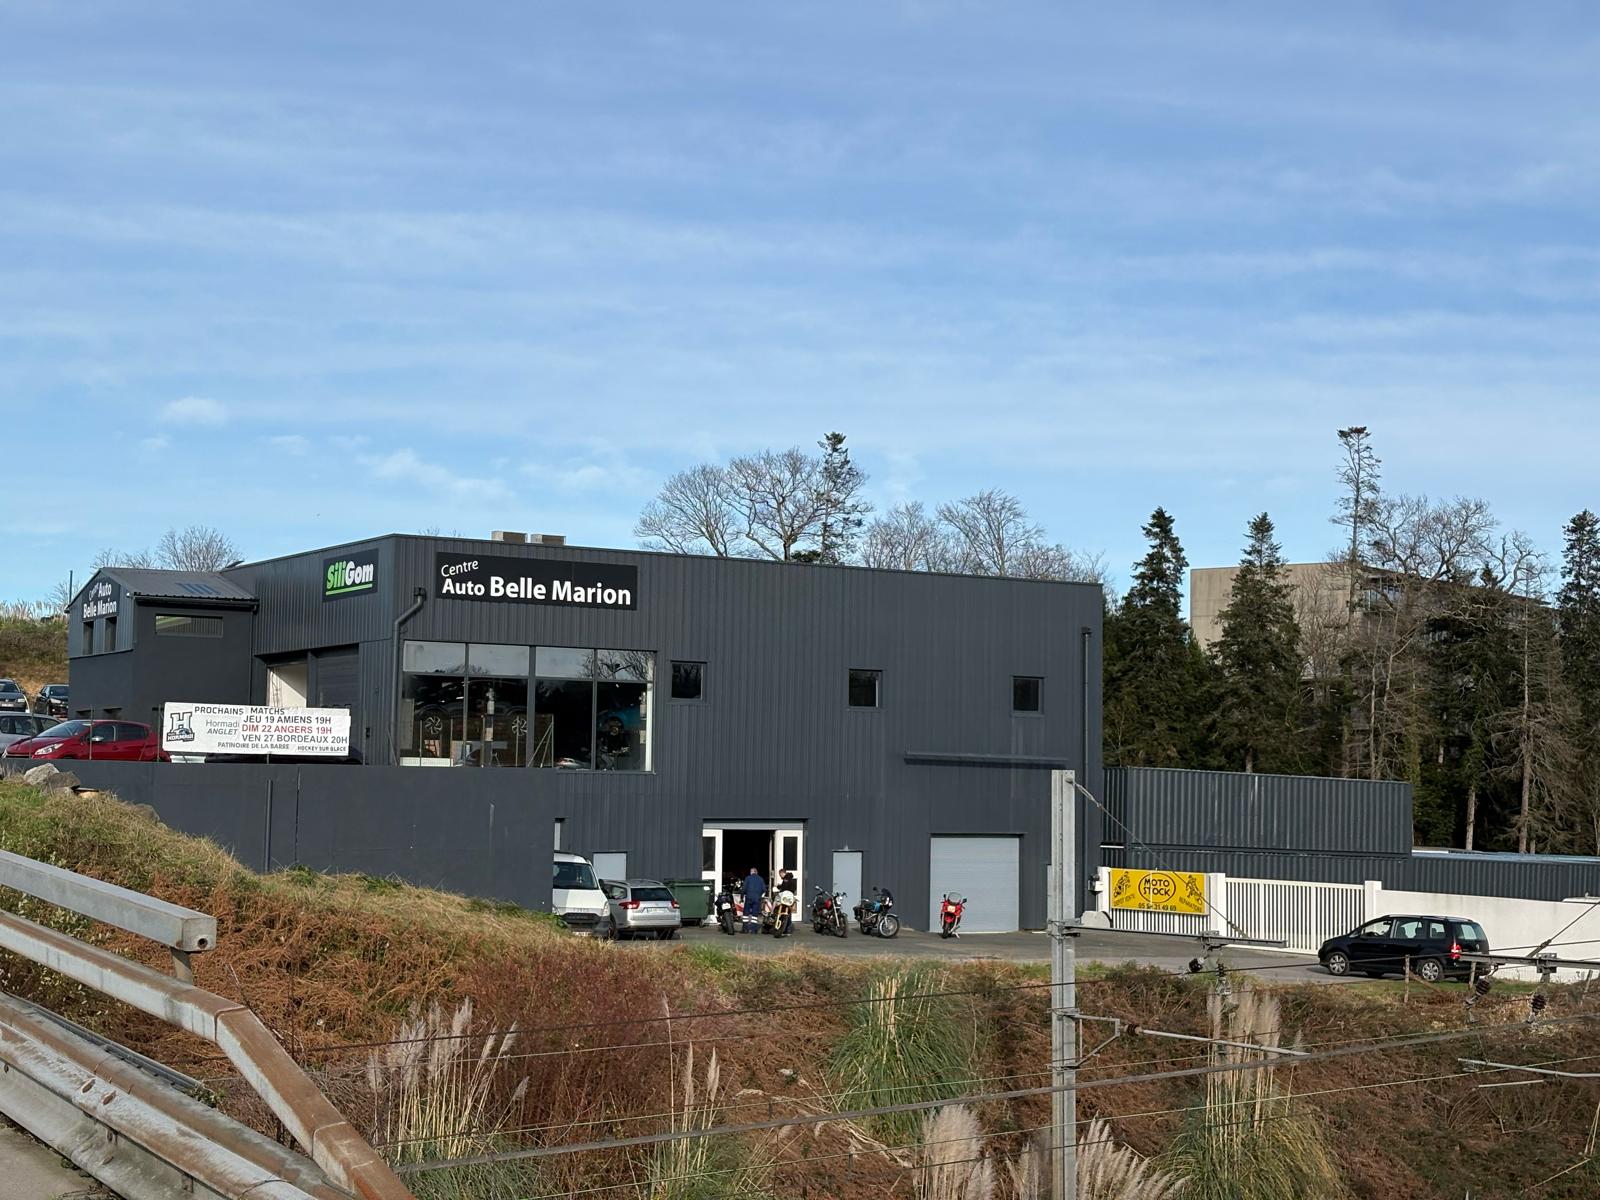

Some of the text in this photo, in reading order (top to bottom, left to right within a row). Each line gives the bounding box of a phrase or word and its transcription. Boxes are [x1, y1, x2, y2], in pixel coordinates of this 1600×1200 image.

[441, 560, 479, 577] Centre
[327, 560, 374, 589] SiliGom
[98, 582, 112, 598] Auto
[442, 576, 631, 605] Auto Belle Marion
[84, 597, 117, 618] Belle Marion
[194, 706, 285, 716] PROCHAINS MATCHS
[206, 720, 240, 728] Hormadi
[244, 715, 262, 723] JEU
[265, 716, 274, 724] 19
[276, 716, 312, 724] AMIENS
[242, 724, 258, 732] DIM
[274, 726, 312, 734] ANGERS
[316, 726, 332, 734] 19H
[242, 734, 260, 742] VEN
[276, 734, 328, 744] BORDEAUX
[1144, 878, 1170, 888] MOTO
[1144, 886, 1170, 896] STOCK
